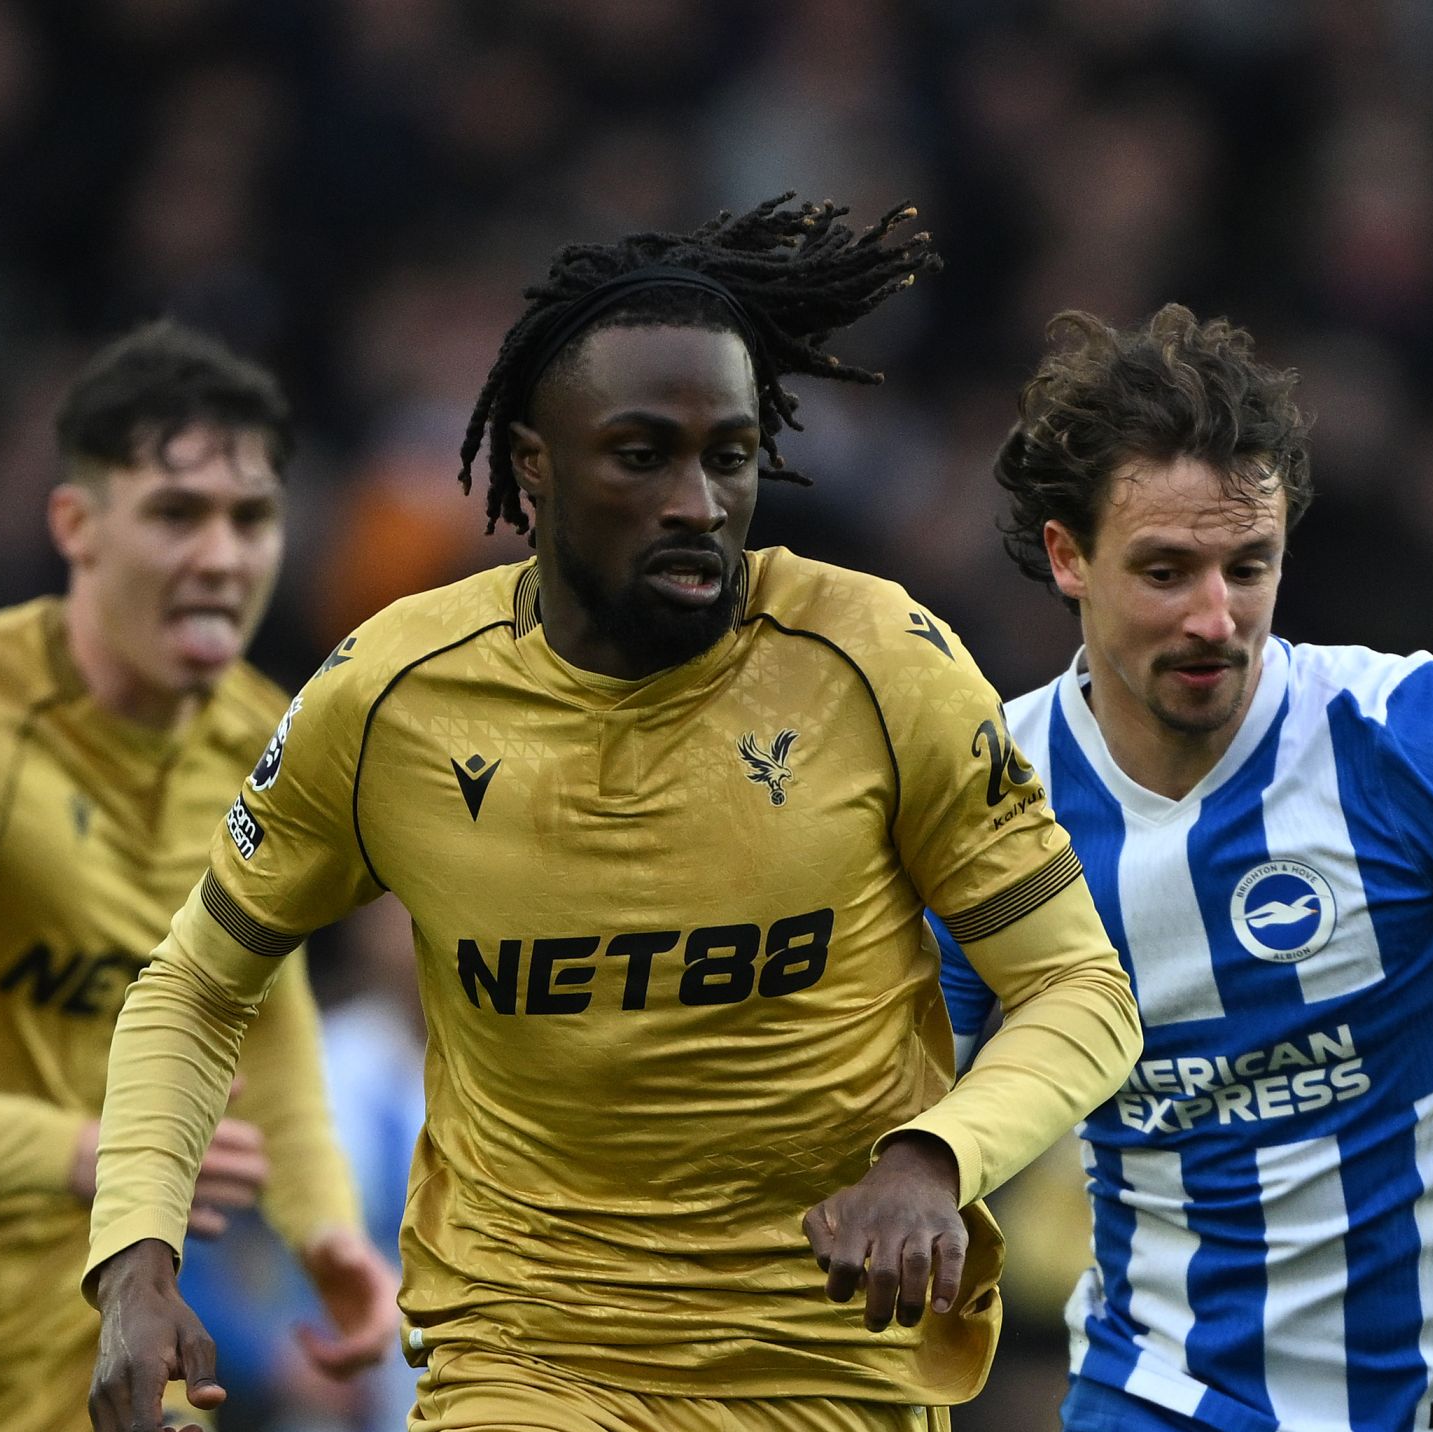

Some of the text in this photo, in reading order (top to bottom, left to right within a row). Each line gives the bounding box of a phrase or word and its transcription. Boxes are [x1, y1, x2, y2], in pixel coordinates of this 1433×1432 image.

[1291, 865, 1318, 884] HOVE
[457, 907, 835, 1015] NET88
[1273, 947, 1311, 960] ALBION
[1117, 1057, 1371, 1134] EXPRESS
